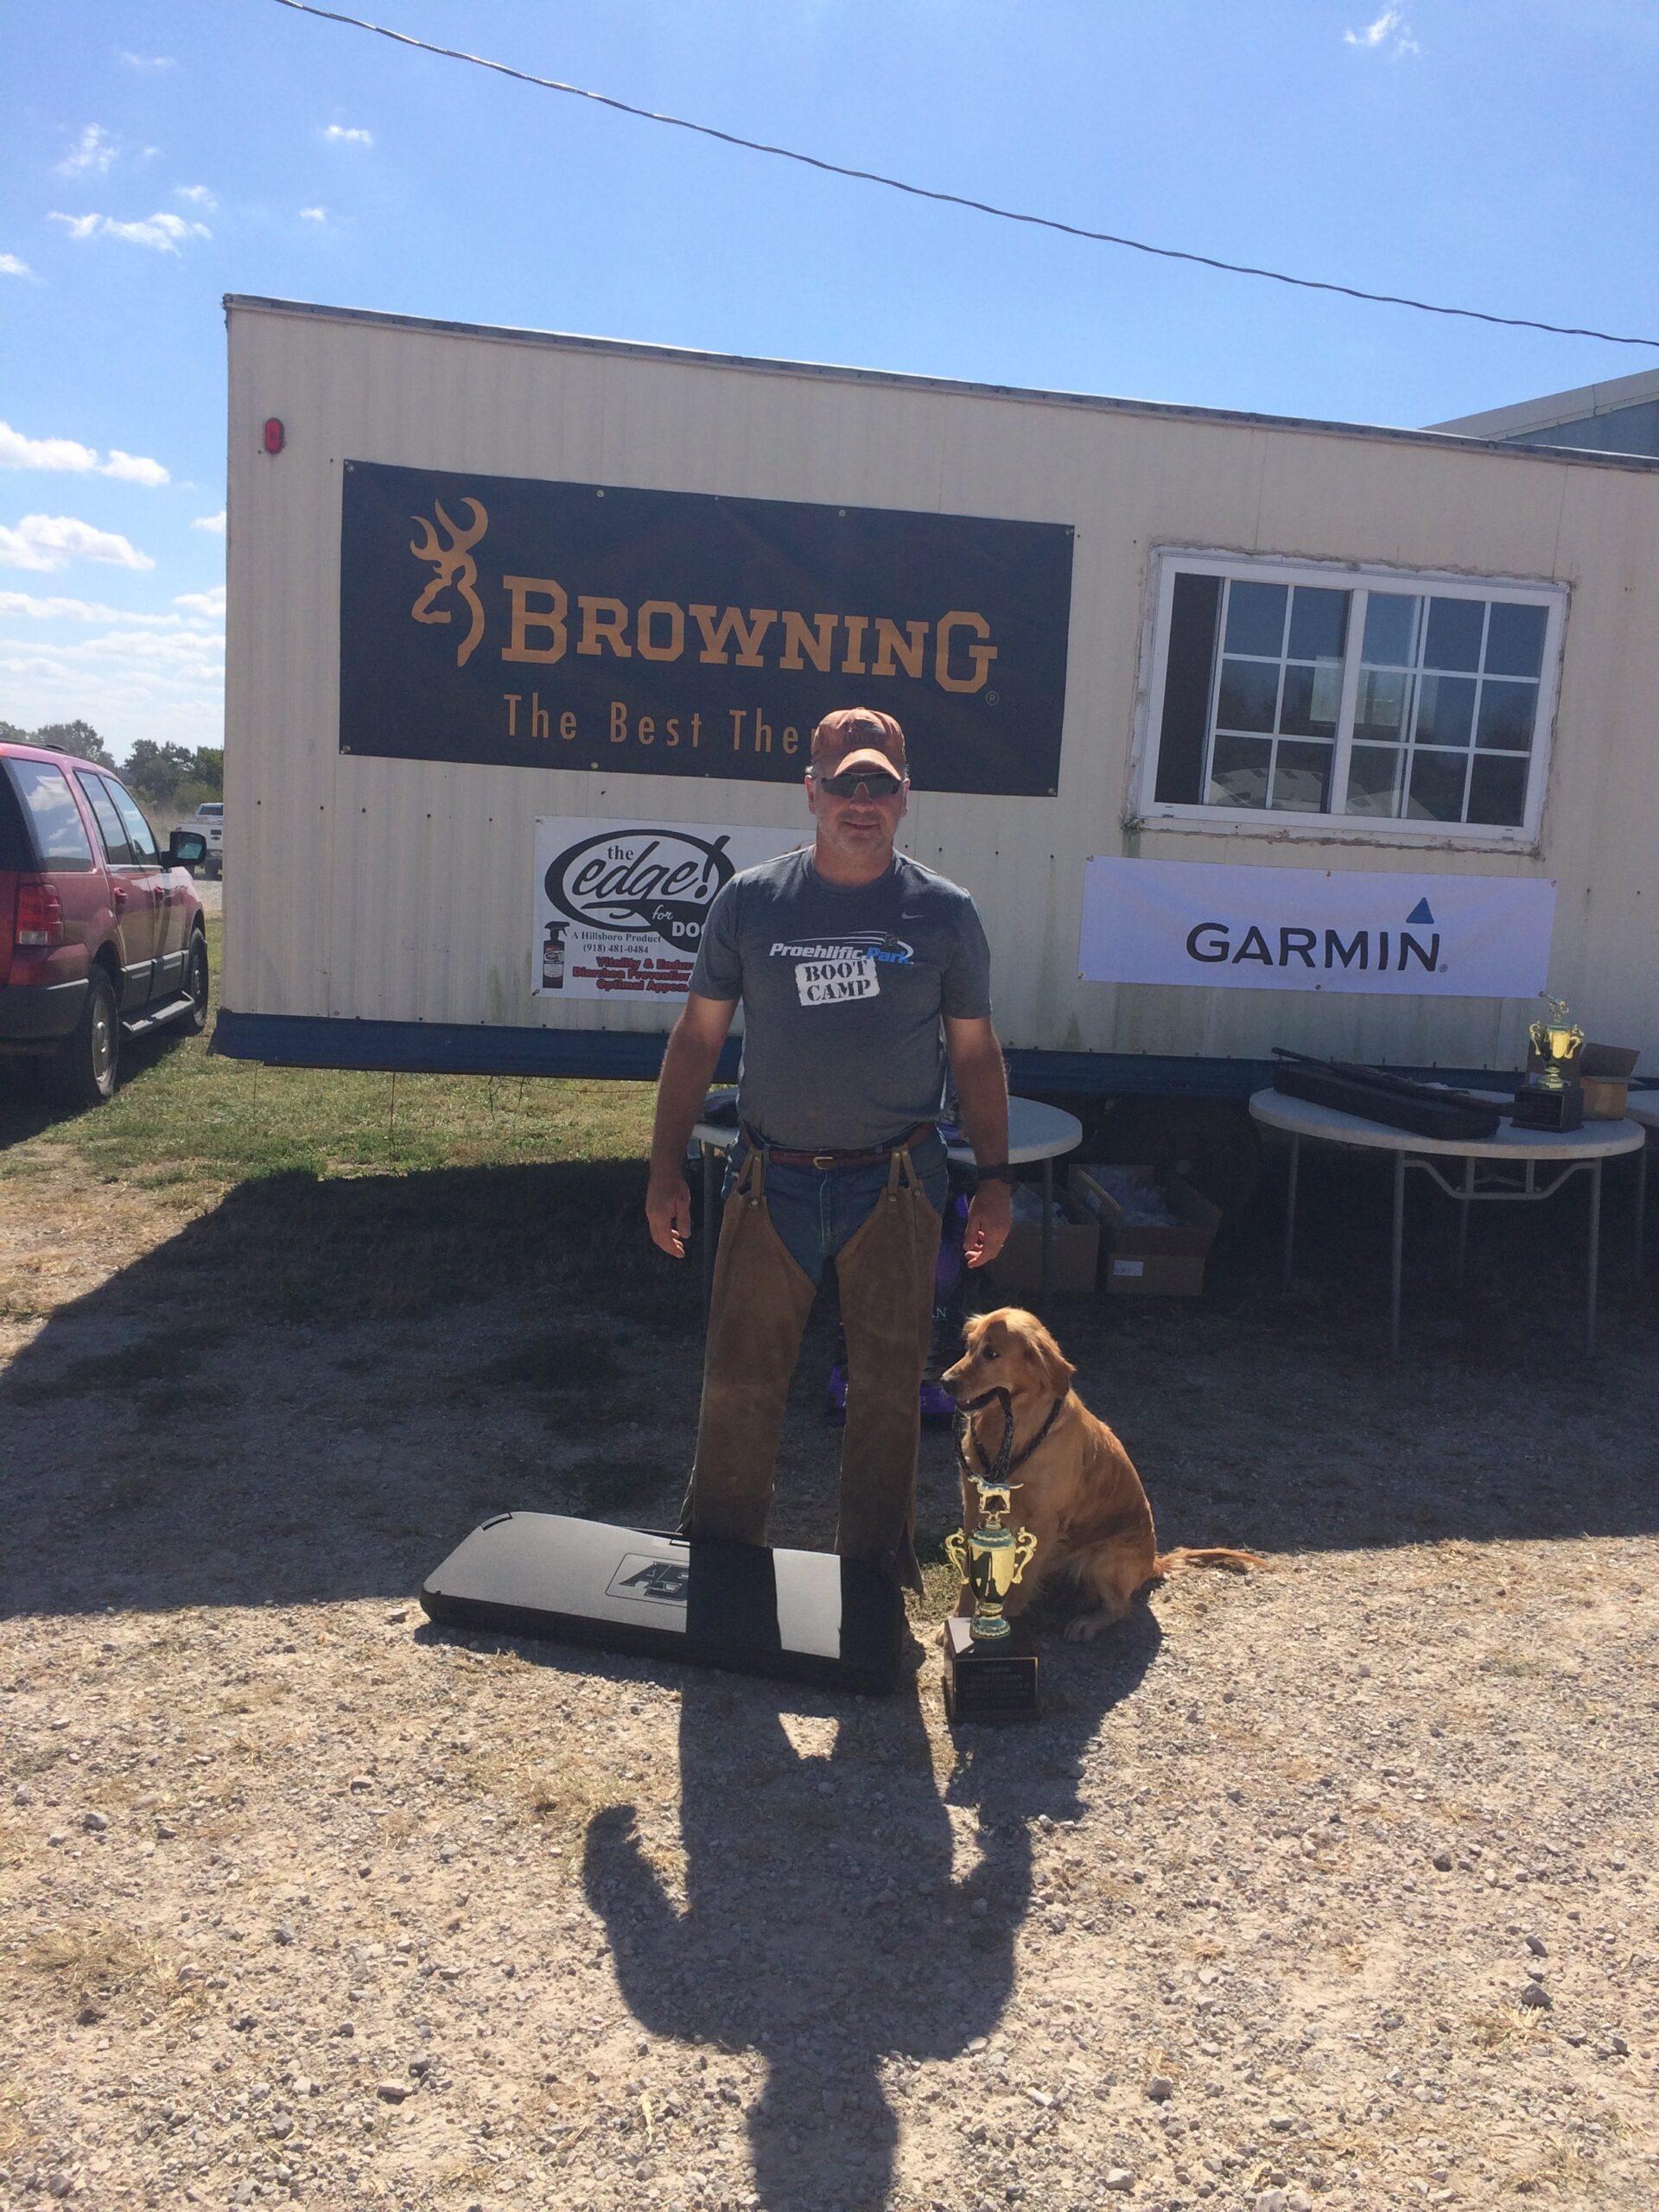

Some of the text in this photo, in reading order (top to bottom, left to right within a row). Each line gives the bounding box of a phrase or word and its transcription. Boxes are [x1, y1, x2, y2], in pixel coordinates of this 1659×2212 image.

[501, 575, 998, 693] BROWNING
[503, 692, 577, 741] The
[610, 701, 702, 748] Best
[607, 845, 634, 861] the
[652, 904, 674, 921] for
[571, 931, 662, 944] A Hillsboro Product
[671, 921, 705, 938] DO
[582, 944, 649, 955] (918) 481-0484
[769, 943, 909, 964] Proehlific Park
[1186, 922, 1440, 972] GARMIN
[804, 960, 868, 982] BOOT
[807, 979, 871, 1001] CAMP
